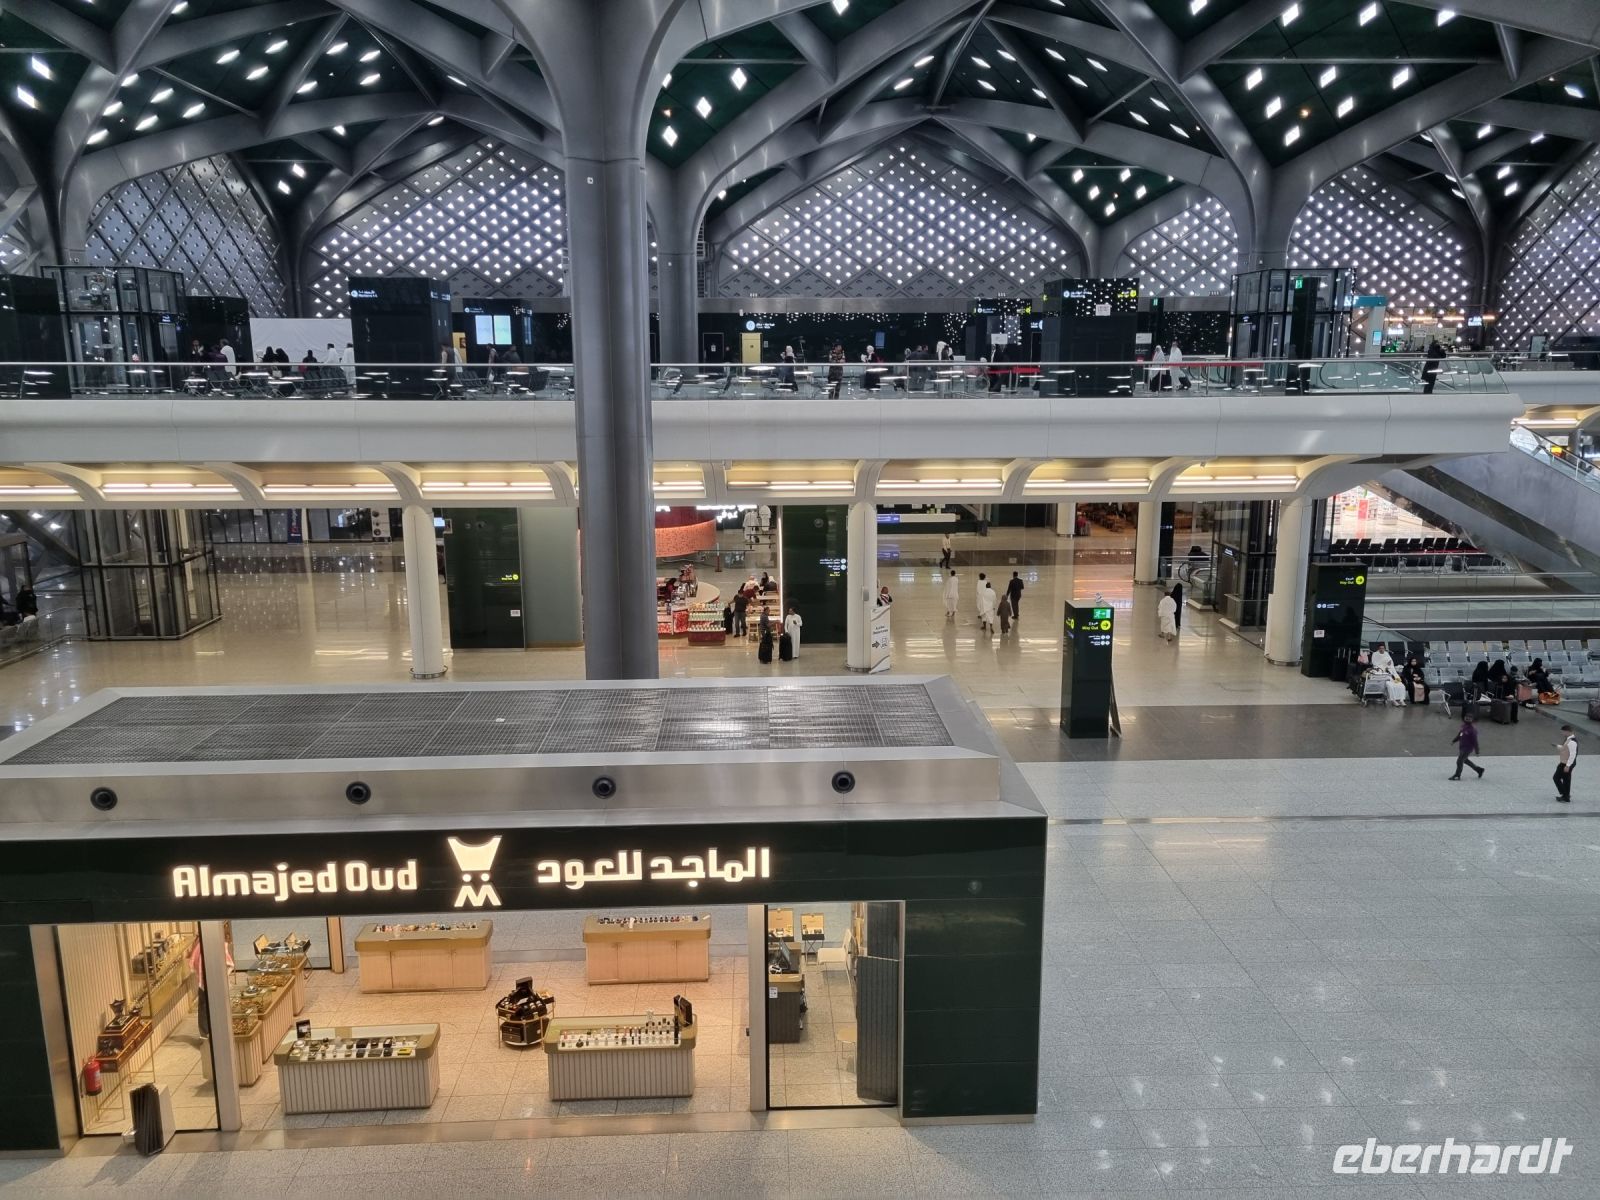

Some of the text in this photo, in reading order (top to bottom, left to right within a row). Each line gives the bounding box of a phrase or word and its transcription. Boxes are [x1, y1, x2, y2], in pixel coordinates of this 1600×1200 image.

[172, 859, 418, 901] Almajed Oud
[537, 847, 770, 889] الماجد للعود
